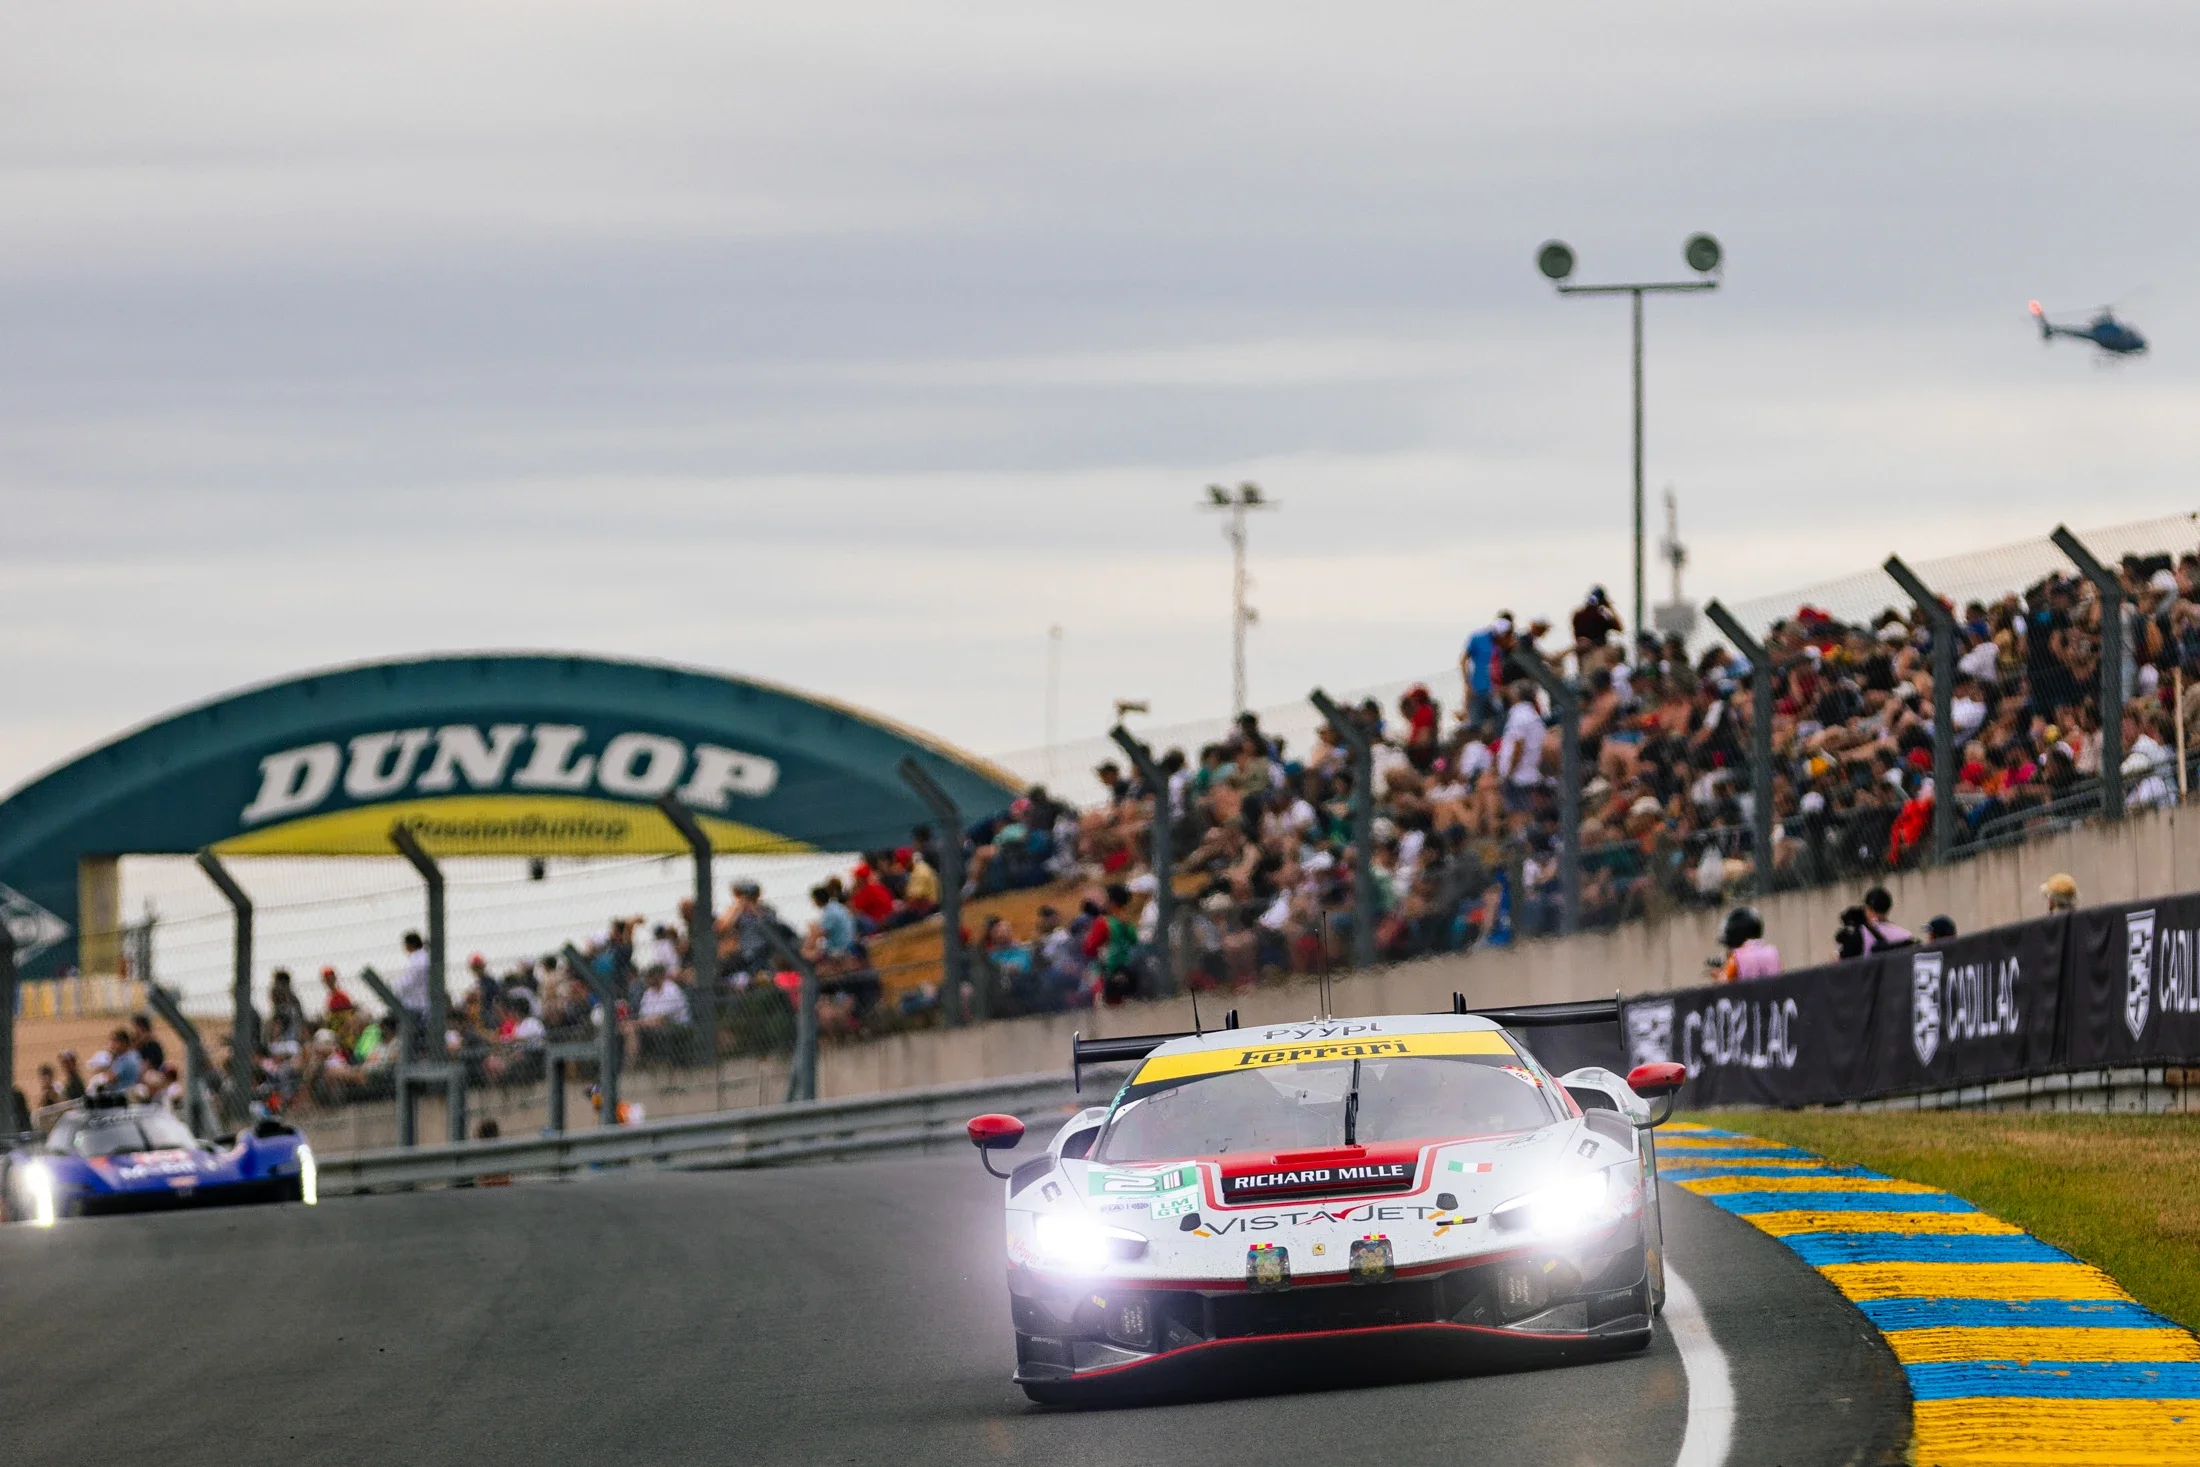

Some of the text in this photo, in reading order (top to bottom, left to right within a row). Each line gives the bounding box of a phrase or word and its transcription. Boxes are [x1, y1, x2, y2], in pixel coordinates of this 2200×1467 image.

[241, 722, 781, 826] DUNLOP
[1946, 955, 2020, 1042] CADILLAC
[1234, 1040, 1411, 1067] Ferrari
[1234, 1165, 1405, 1189] RICHARD MILLE
[1157, 1203, 1194, 1217] GT3
[1160, 1197, 1190, 1210] LM
